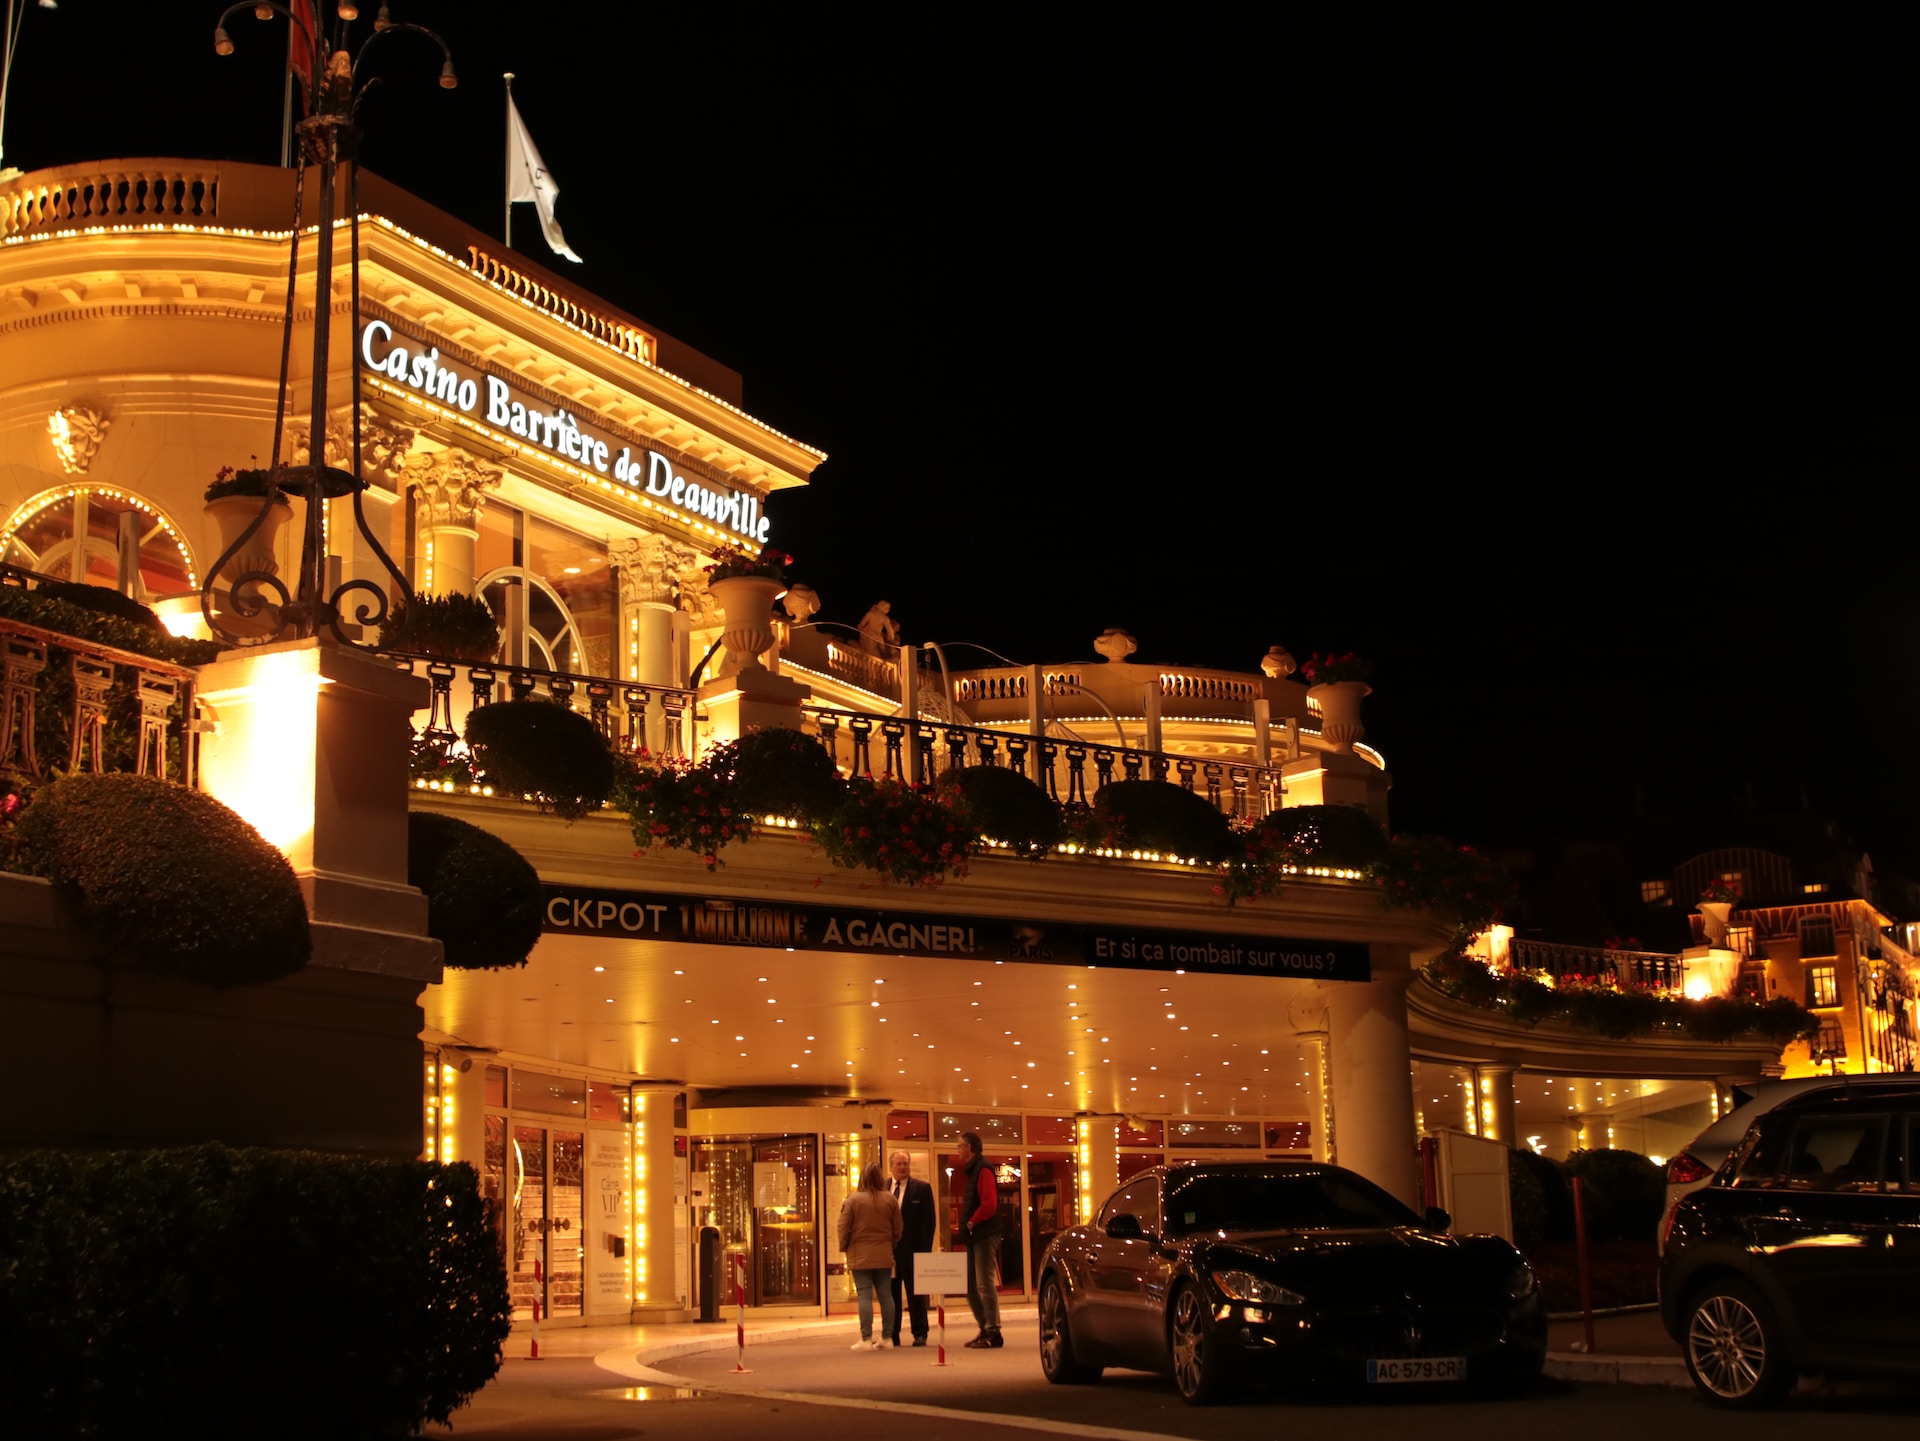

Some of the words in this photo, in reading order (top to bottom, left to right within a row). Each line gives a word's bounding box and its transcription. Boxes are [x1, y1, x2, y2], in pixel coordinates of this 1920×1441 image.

[361, 319, 478, 412] Casino
[487, 374, 610, 473] Barrière
[614, 447, 641, 487] de
[646, 450, 771, 544] Deauville
[541, 896, 668, 933] CKPOT
[694, 903, 791, 947] MILLION
[846, 919, 975, 953] GAGNER!
[1095, 937, 1116, 958] Et
[1120, 936, 1137, 959] si
[1247, 949, 1276, 968] sur
[1279, 952, 1324, 971] vous
